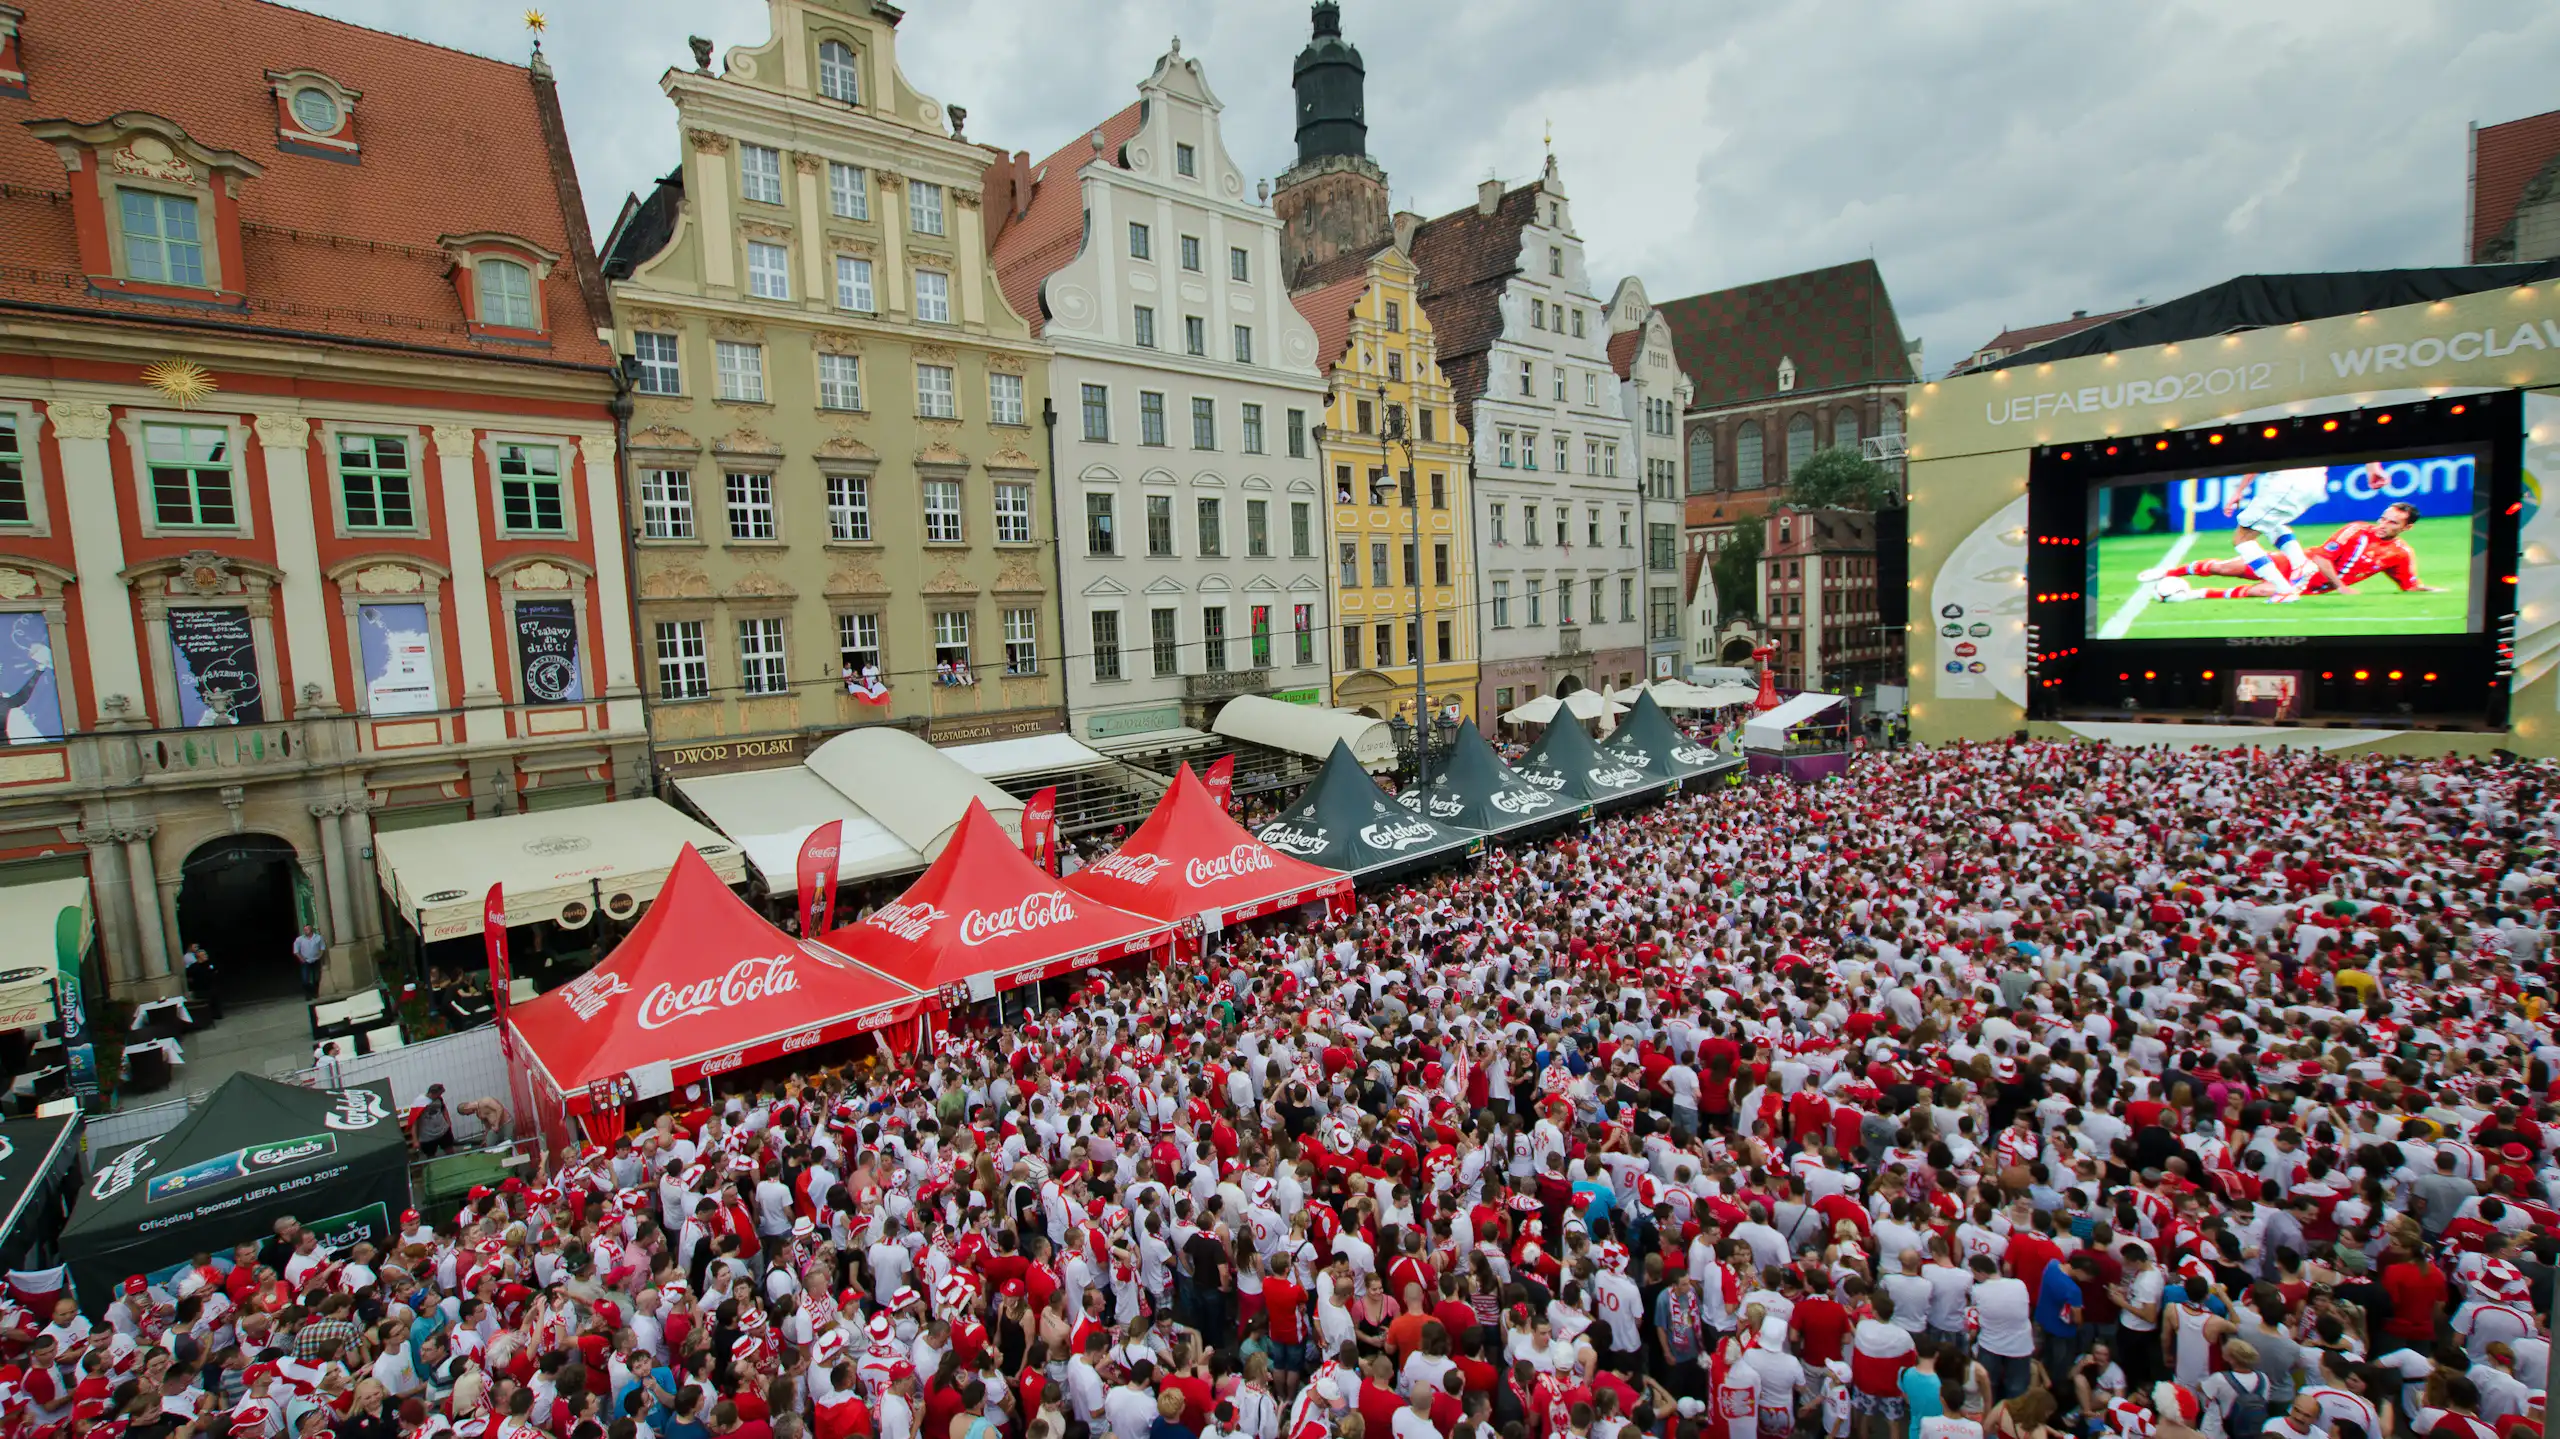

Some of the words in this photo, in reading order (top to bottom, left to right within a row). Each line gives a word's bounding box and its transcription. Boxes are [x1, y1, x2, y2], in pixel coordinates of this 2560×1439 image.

[520, 620, 540, 634] gry
[537, 626, 571, 638] zabawy
[527, 642, 567, 653] dzieci
[2225, 636, 2308, 647] SHARP
[931, 727, 991, 743] RESTAURACJA
[1011, 721, 1041, 733] HOTEL
[1105, 711, 1165, 731] Lwowska
[673, 745, 728, 765] DWÓR
[736, 738, 793, 759] POLSKI
[1490, 785, 1555, 815] Carlsberg
[1257, 822, 1330, 855] Carlsberg
[1360, 815, 1438, 851] Carlsberg
[808, 846, 838, 859] Coca-Cola
[1185, 843, 1274, 888] Coca-Cola
[960, 890, 1078, 947] Coca-Cola
[1015, 967, 1045, 985] Coca-Cola
[636, 954, 801, 1030] Coca-Cola
[857, 1009, 894, 1031] Coca-Cola
[782, 1029, 822, 1053] Coca-Cola
[700, 1050, 744, 1076] Coca-Cola
[252, 1139, 324, 1165] Carlsberg
[1624, 1171, 1635, 1188] 9
[138, 1209, 195, 1233] Oficjalny
[195, 1195, 244, 1217] Sponsor
[245, 1184, 278, 1202] UEFA
[279, 1175, 313, 1193] EURO
[1971, 1238, 1991, 1256] 10
[1598, 1287, 1620, 1312] 10
